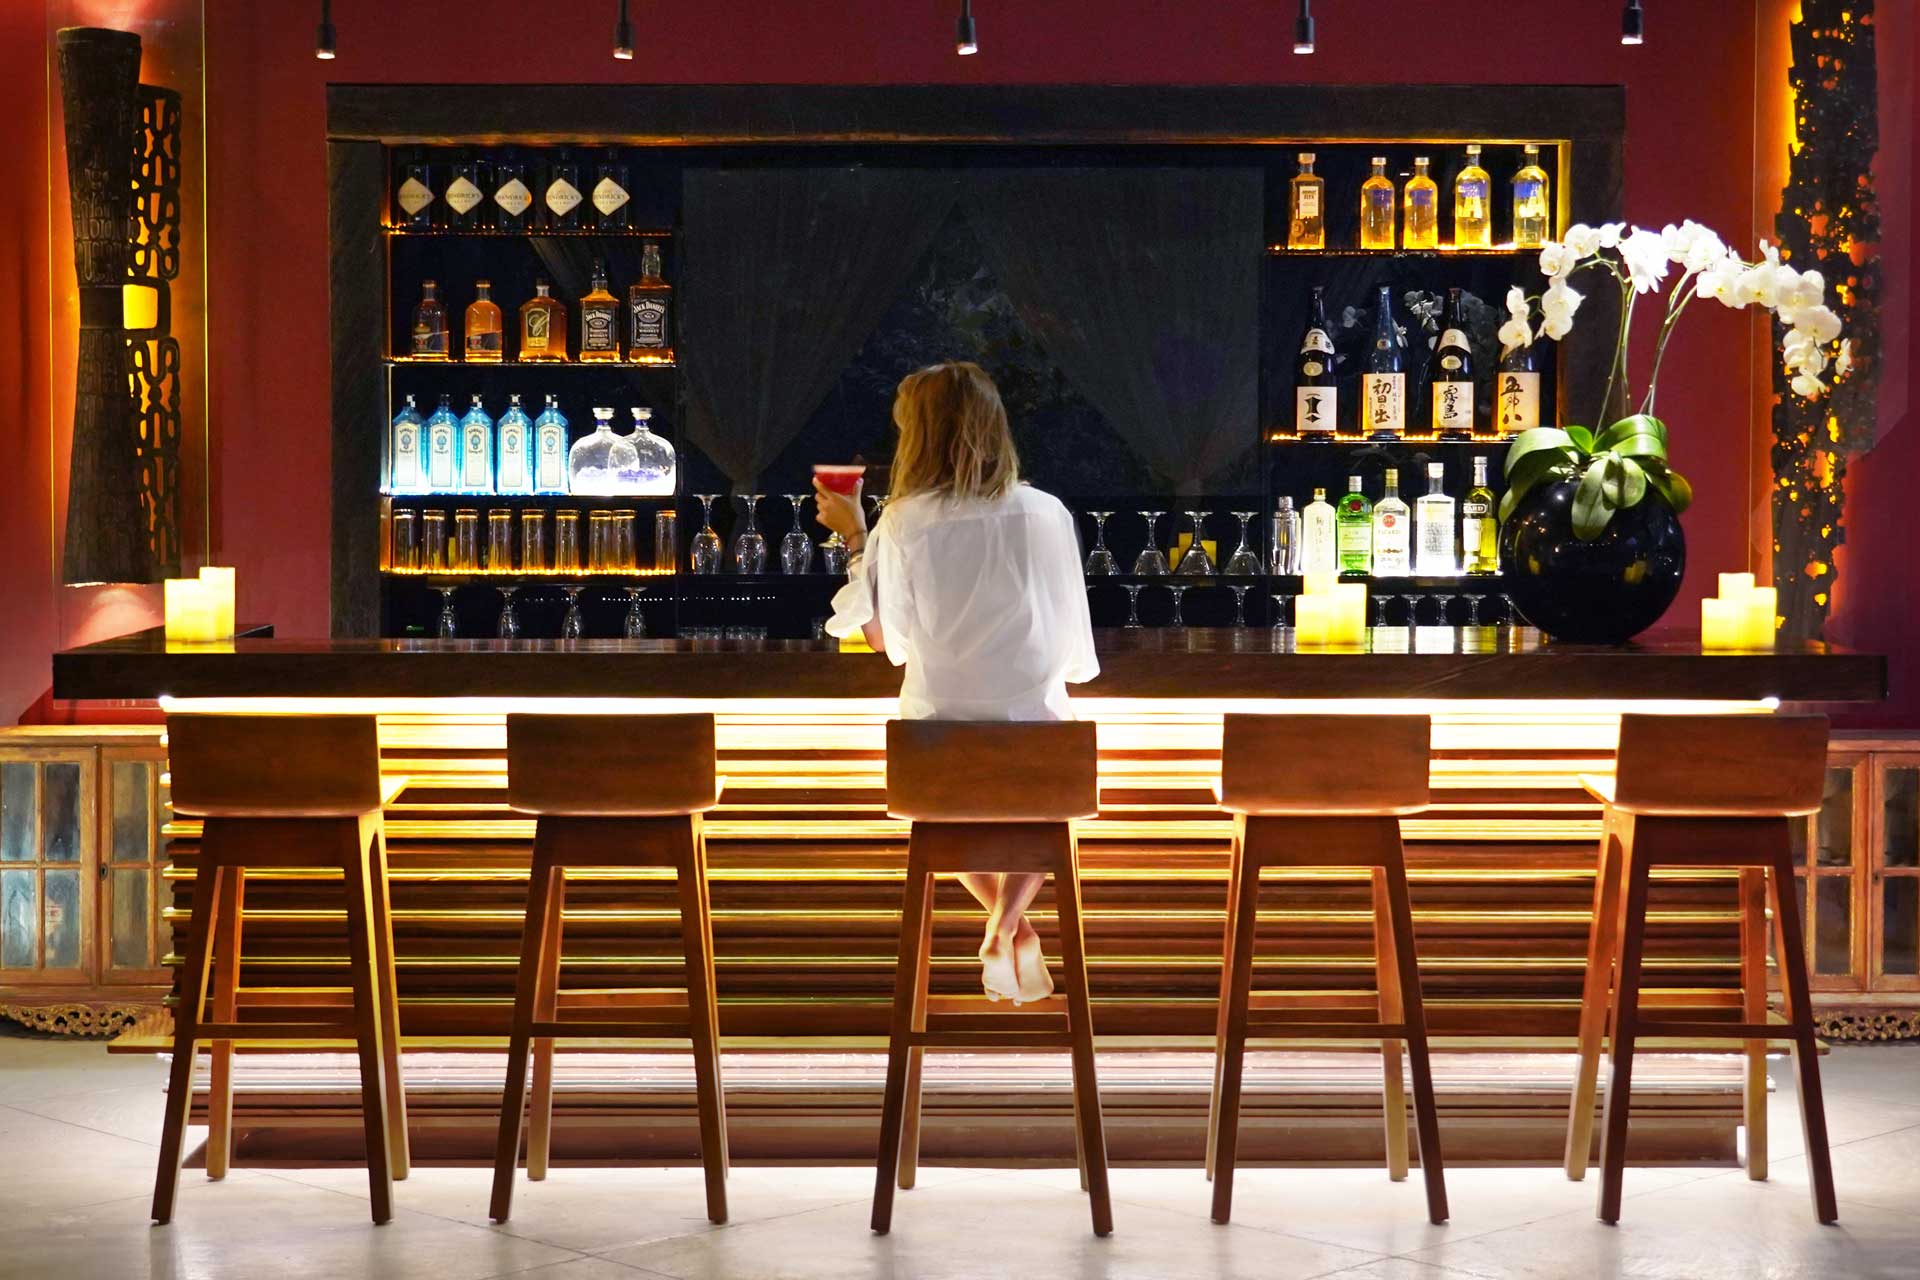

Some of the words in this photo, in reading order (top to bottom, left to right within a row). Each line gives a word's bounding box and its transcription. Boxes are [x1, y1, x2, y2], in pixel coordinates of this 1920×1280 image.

[633, 303, 646, 314] JACK
[1372, 378, 1392, 424] 初日の出
